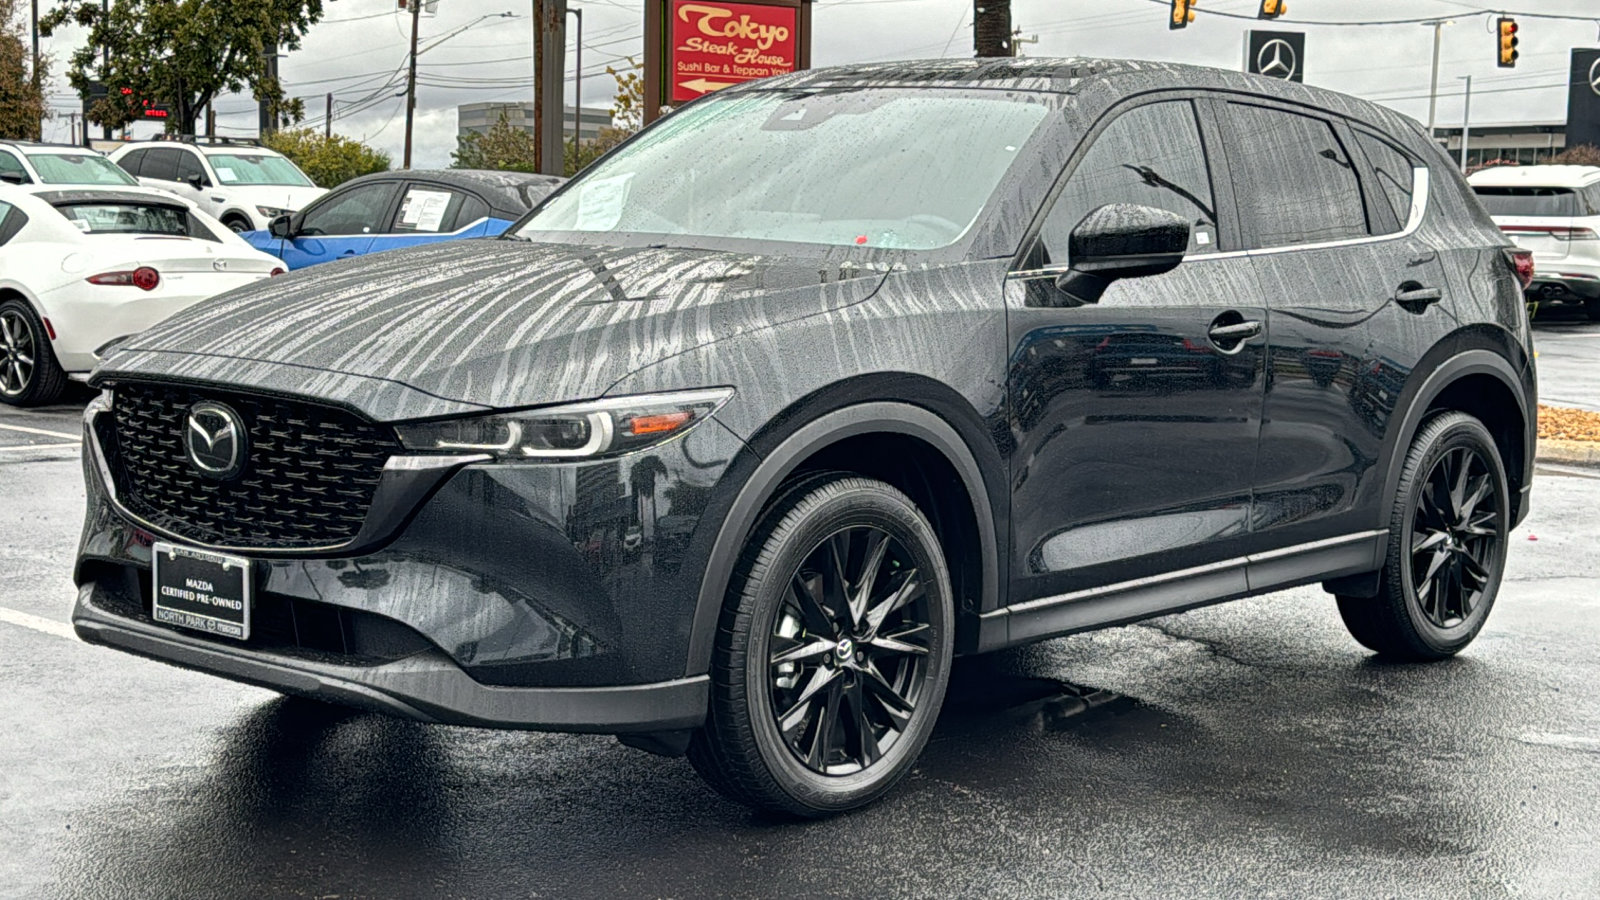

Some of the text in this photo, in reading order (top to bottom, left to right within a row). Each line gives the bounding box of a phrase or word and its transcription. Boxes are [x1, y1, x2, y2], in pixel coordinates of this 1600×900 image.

[678, 4, 789, 50] Tokyo
[677, 37, 793, 67] Steak House
[677, 61, 702, 72] Sushi
[704, 63, 720, 74] Bar
[723, 64, 731, 74] &
[733, 65, 769, 76] Teppan
[185, 578, 214, 592] MAZDA
[161, 586, 242, 610] CERTIFIED PRE-OWNED
[158, 610, 184, 624] NORTH
[185, 615, 206, 629] PARK
